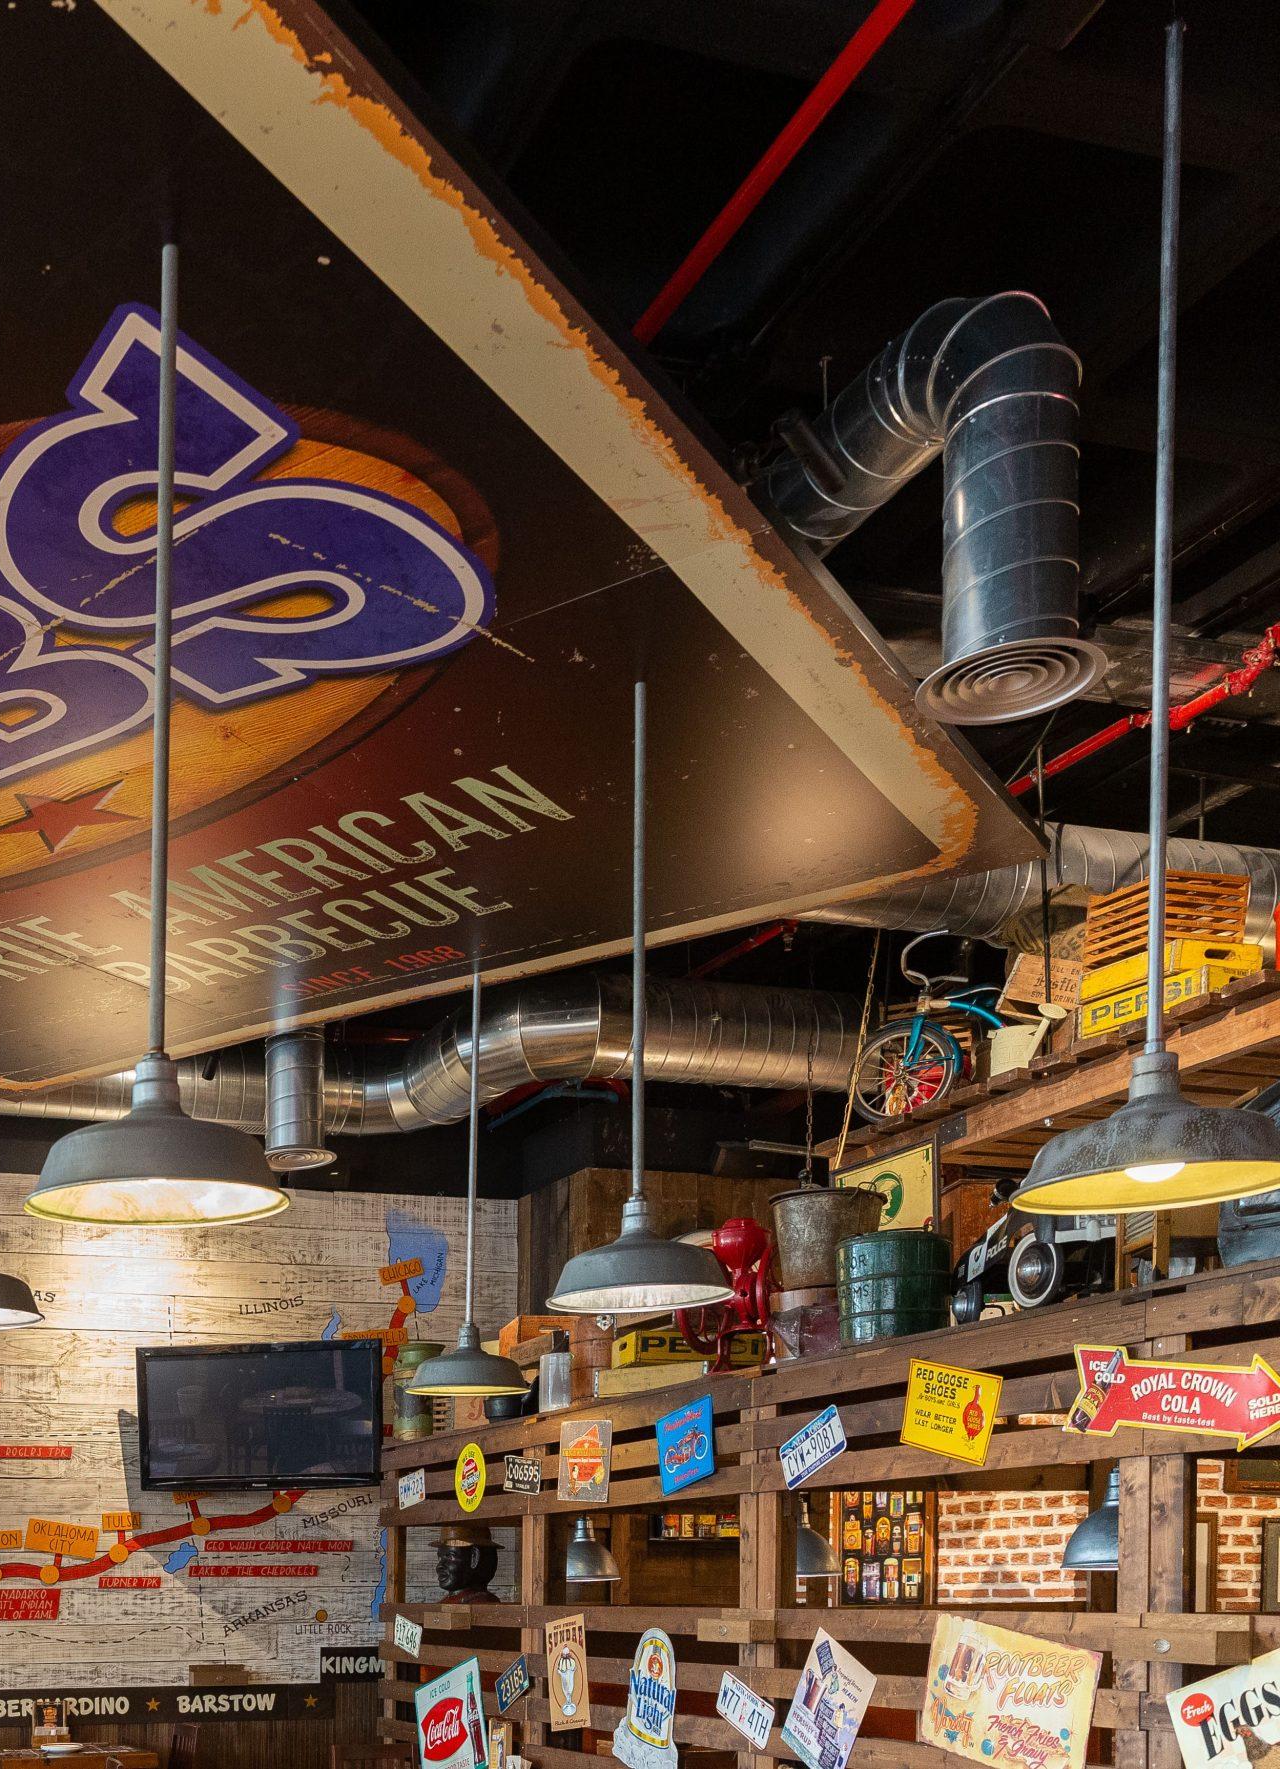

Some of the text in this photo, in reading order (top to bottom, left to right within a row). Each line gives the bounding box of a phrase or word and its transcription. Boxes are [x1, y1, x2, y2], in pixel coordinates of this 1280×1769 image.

[109, 764, 576, 938] AMERICAN
[99, 866, 514, 997] BARBECUE
[280, 942, 467, 999] SINCE 1968
[986, 1235, 1008, 1261] POLICE
[382, 1262, 421, 1281] CHICAGO
[430, 1253, 443, 1286] MICHIGAN
[413, 1278, 428, 1294] LAKE
[239, 1295, 304, 1315] ILLINOIS
[642, 1336, 759, 1355] PESI
[1089, 1361, 1108, 1371] ICE
[916, 1368, 969, 1389] RED GOOSE
[1094, 1372, 1126, 1384] COLD
[924, 1383, 957, 1400] SHOES
[1130, 1372, 1177, 1401] ROYAL
[1181, 1372, 1238, 1408] CROWN
[1161, 1394, 1201, 1415] COLA
[1248, 1392, 1280, 1410] SOLD
[915, 1408, 956, 1425] WEAR BETTER
[1142, 1412, 1216, 1427] Best by taste-test
[1249, 1406, 1280, 1421] HERE
[931, 1422, 953, 1434] LONGER
[105, 1515, 139, 1528] TULSA
[302, 1494, 373, 1529] MISSOURI
[33, 1521, 95, 1543] OKLAHOMA
[49, 1539, 74, 1551] CITY
[206, 1541, 352, 1551] GEO WASH CARVER MON
[191, 1566, 317, 1576] LAKE OF THE CHEROKEES
[101, 1578, 159, 1587] TURNER TPK
[13, 1611, 22, 1620] OF
[28, 1610, 53, 1620] FAME
[20, 1600, 53, 1610] INDIAN
[223, 1590, 308, 1638] ARKANSAS
[295, 1624, 352, 1635] LITTLE ROCK
[548, 1626, 583, 1656] SUNDAE
[430, 1681, 450, 1699] ICE COLD
[631, 1669, 675, 1715] Natural
[842, 1688, 859, 1703] HEALTH
[997, 1677, 1075, 1711] FLOATS
[177, 1693, 276, 1715] BARSTOW
[636, 1698, 663, 1730] Light
[1183, 1701, 1212, 1719] Fresh
[748, 1708, 769, 1739] 4TH
[792, 1710, 818, 1738] HERSHEY'S
[1198, 1681, 1280, 1761] EGGS
[793, 1725, 812, 1746] SYRUP
[988, 1714, 1060, 1749] French Fries
[993, 1735, 1049, 1769] & Gravy
